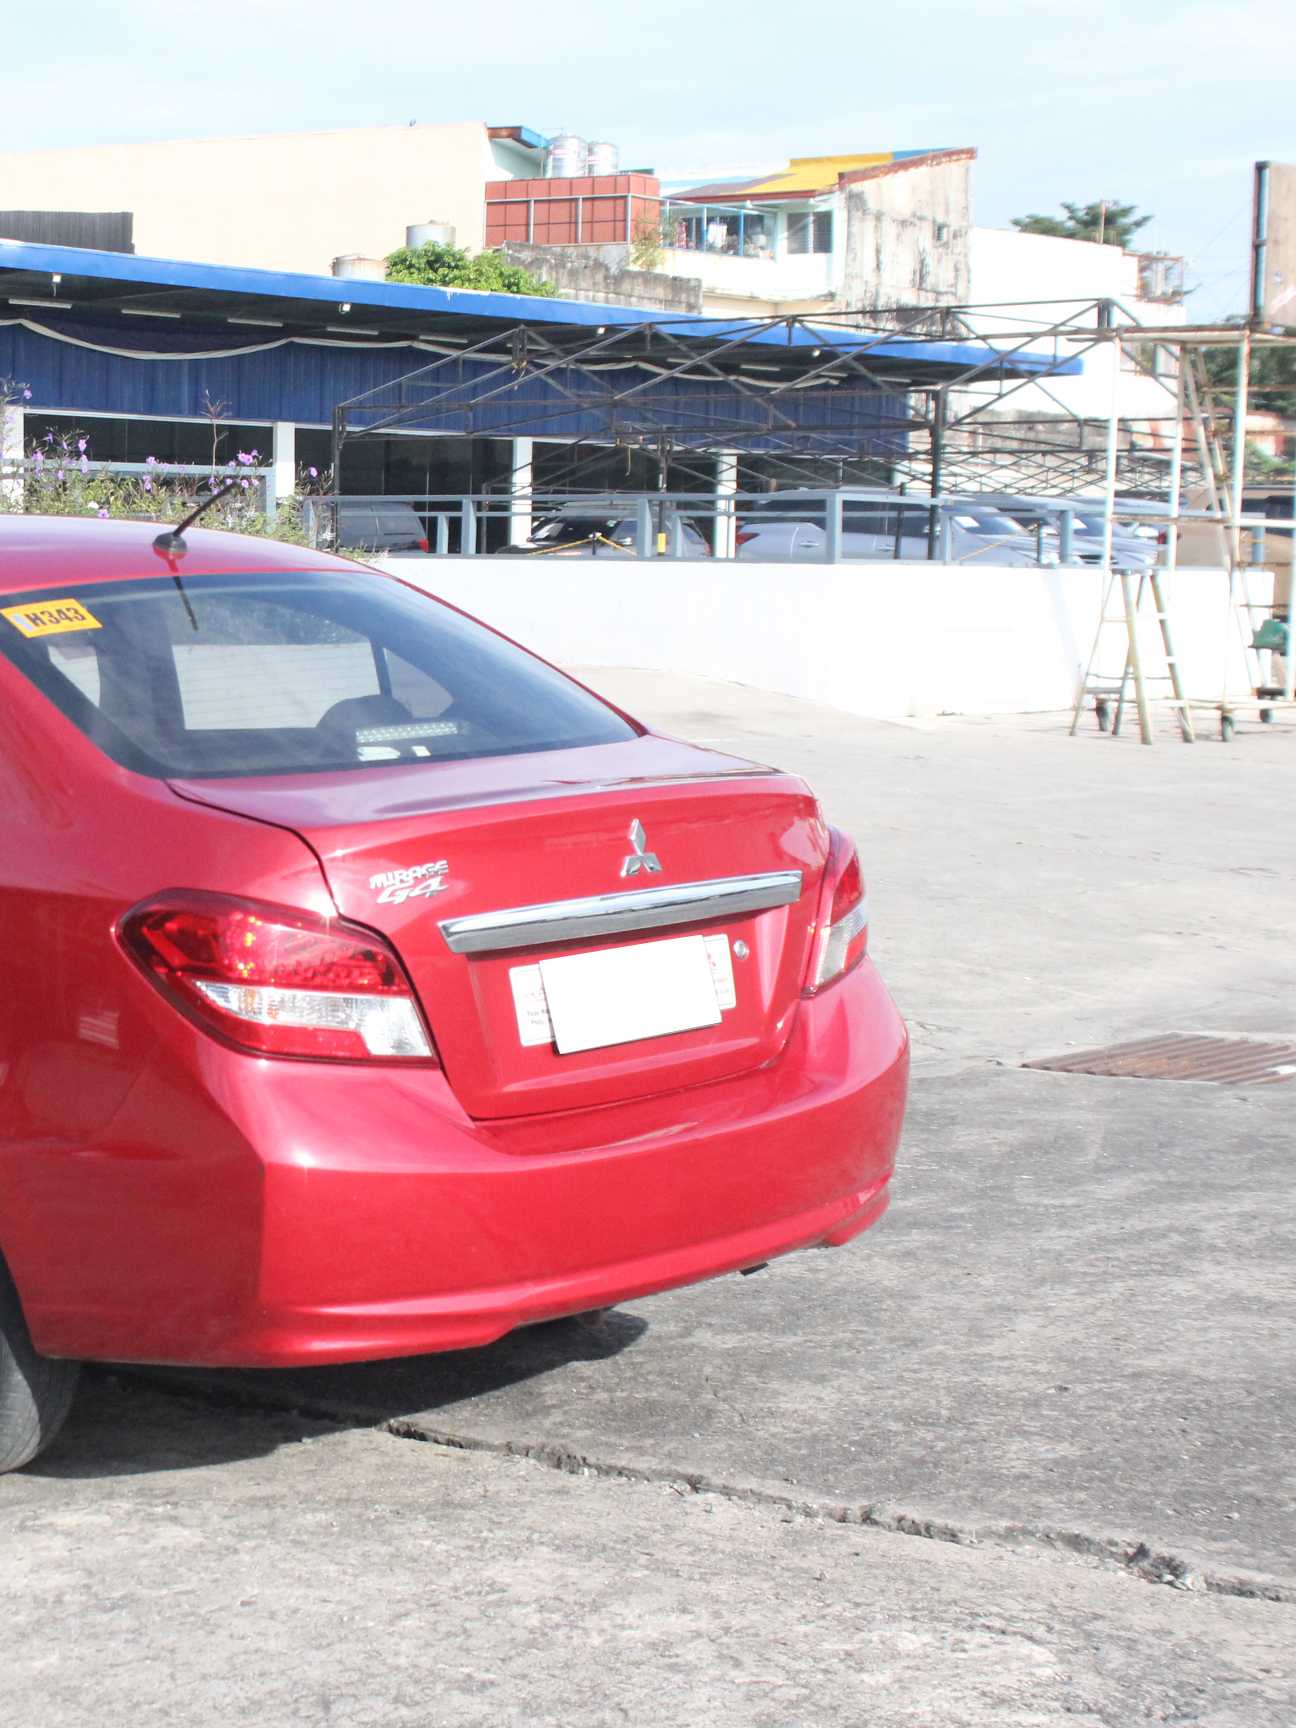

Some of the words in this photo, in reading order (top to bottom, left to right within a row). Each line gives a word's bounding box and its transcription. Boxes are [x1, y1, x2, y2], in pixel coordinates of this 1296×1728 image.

[24, 607, 86, 627] H343
[369, 859, 448, 889] MIRAGE
[376, 876, 448, 904] G4
